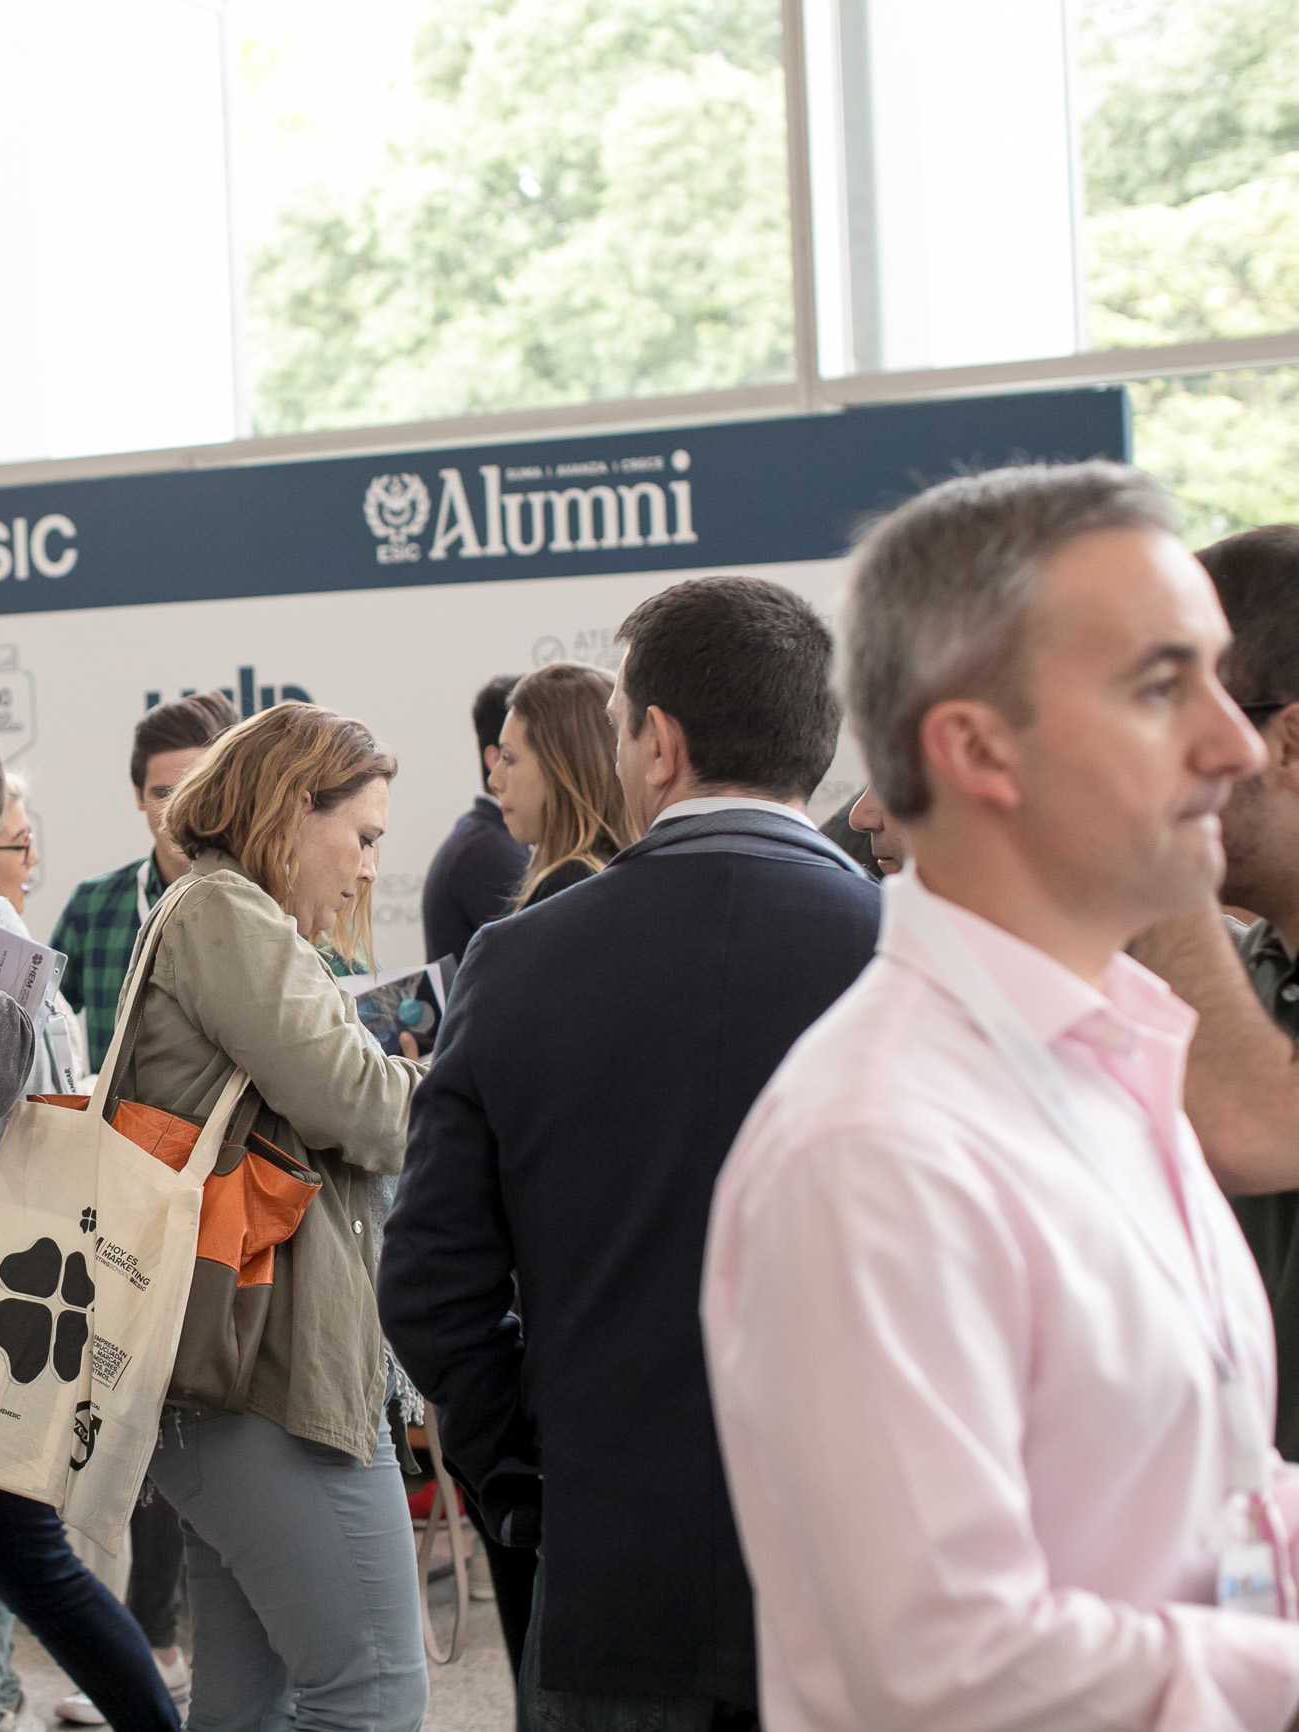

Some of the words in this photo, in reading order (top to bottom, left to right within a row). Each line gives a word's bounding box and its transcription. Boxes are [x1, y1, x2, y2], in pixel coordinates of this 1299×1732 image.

[428, 448, 699, 561] Alumni
[101, 1249, 151, 1287] MARKETING
[106, 1242, 127, 1257] HOY
[126, 1254, 139, 1266] ES
